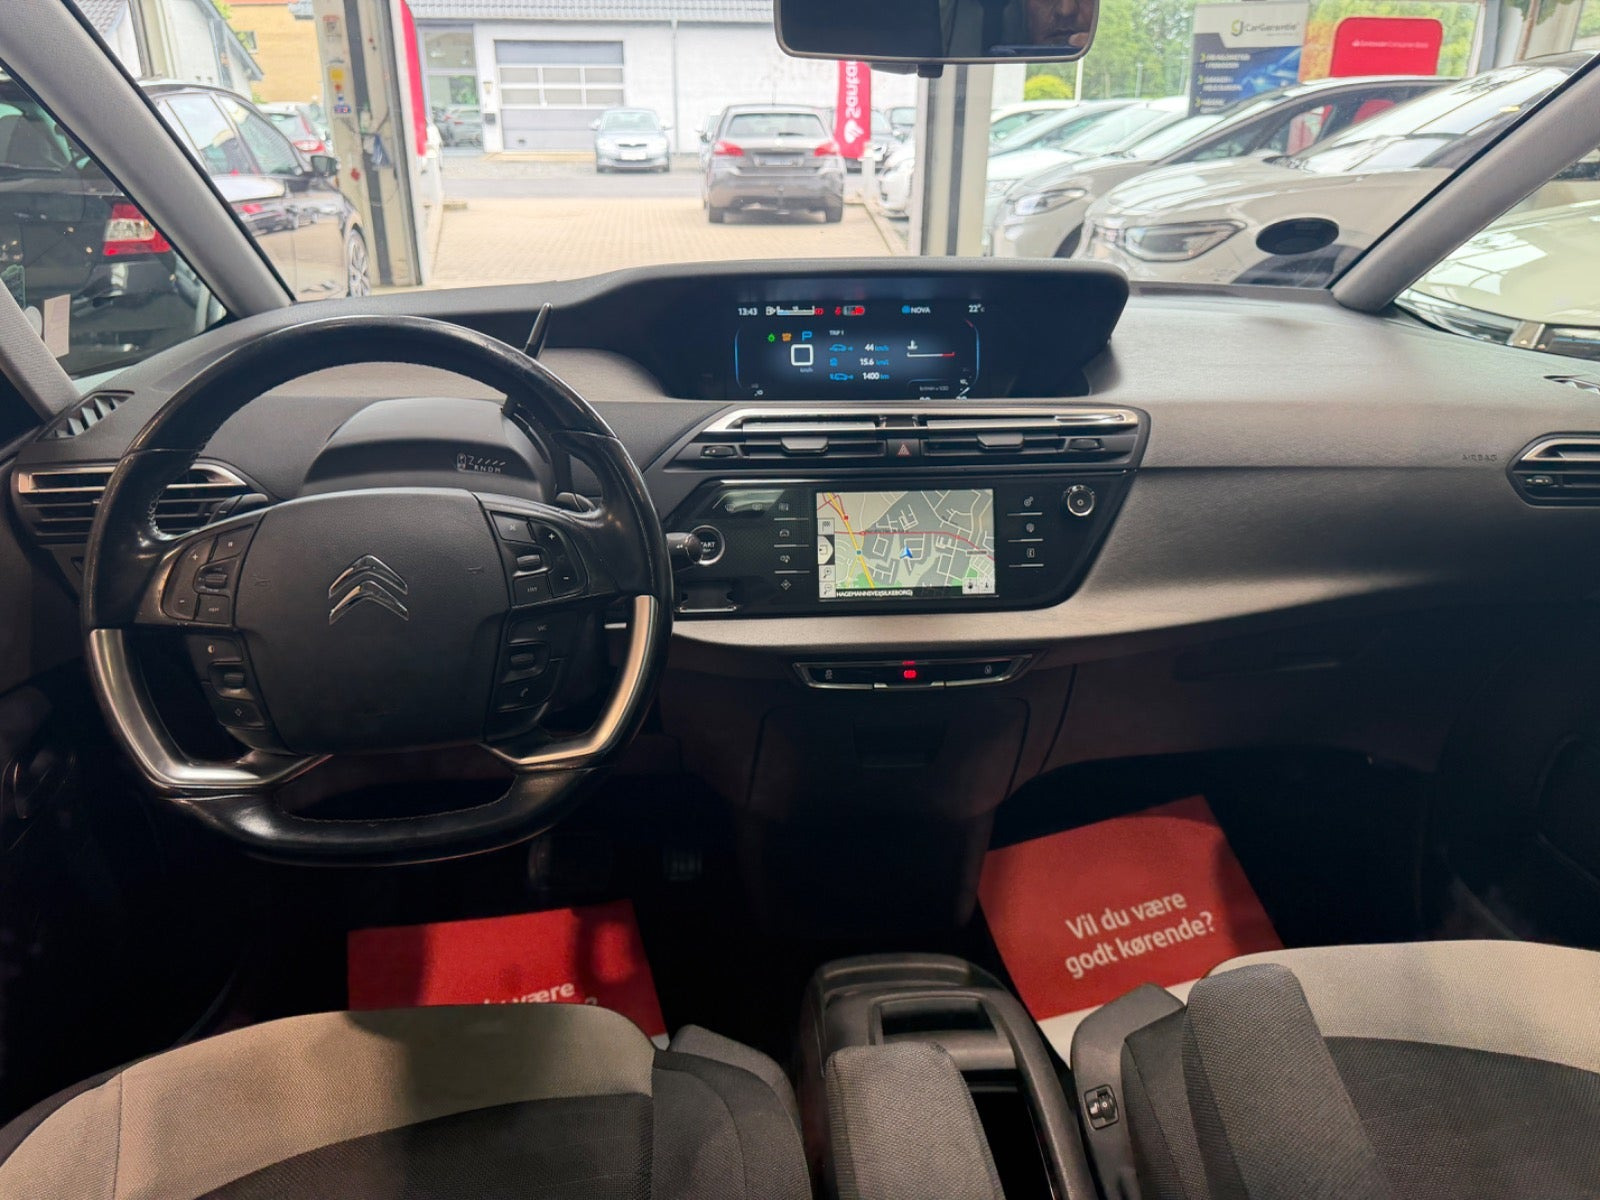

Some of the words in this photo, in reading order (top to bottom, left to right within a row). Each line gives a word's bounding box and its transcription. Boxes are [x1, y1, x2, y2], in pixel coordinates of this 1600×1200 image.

[738, 307, 758, 316] 13:43
[864, 344, 874, 352] 44
[863, 372, 880, 380] 1400
[1065, 912, 1099, 940] Vil
[1101, 908, 1131, 932] du
[1131, 893, 1187, 921] være
[1065, 942, 1119, 980] godt
[1115, 911, 1215, 958] kørende?
